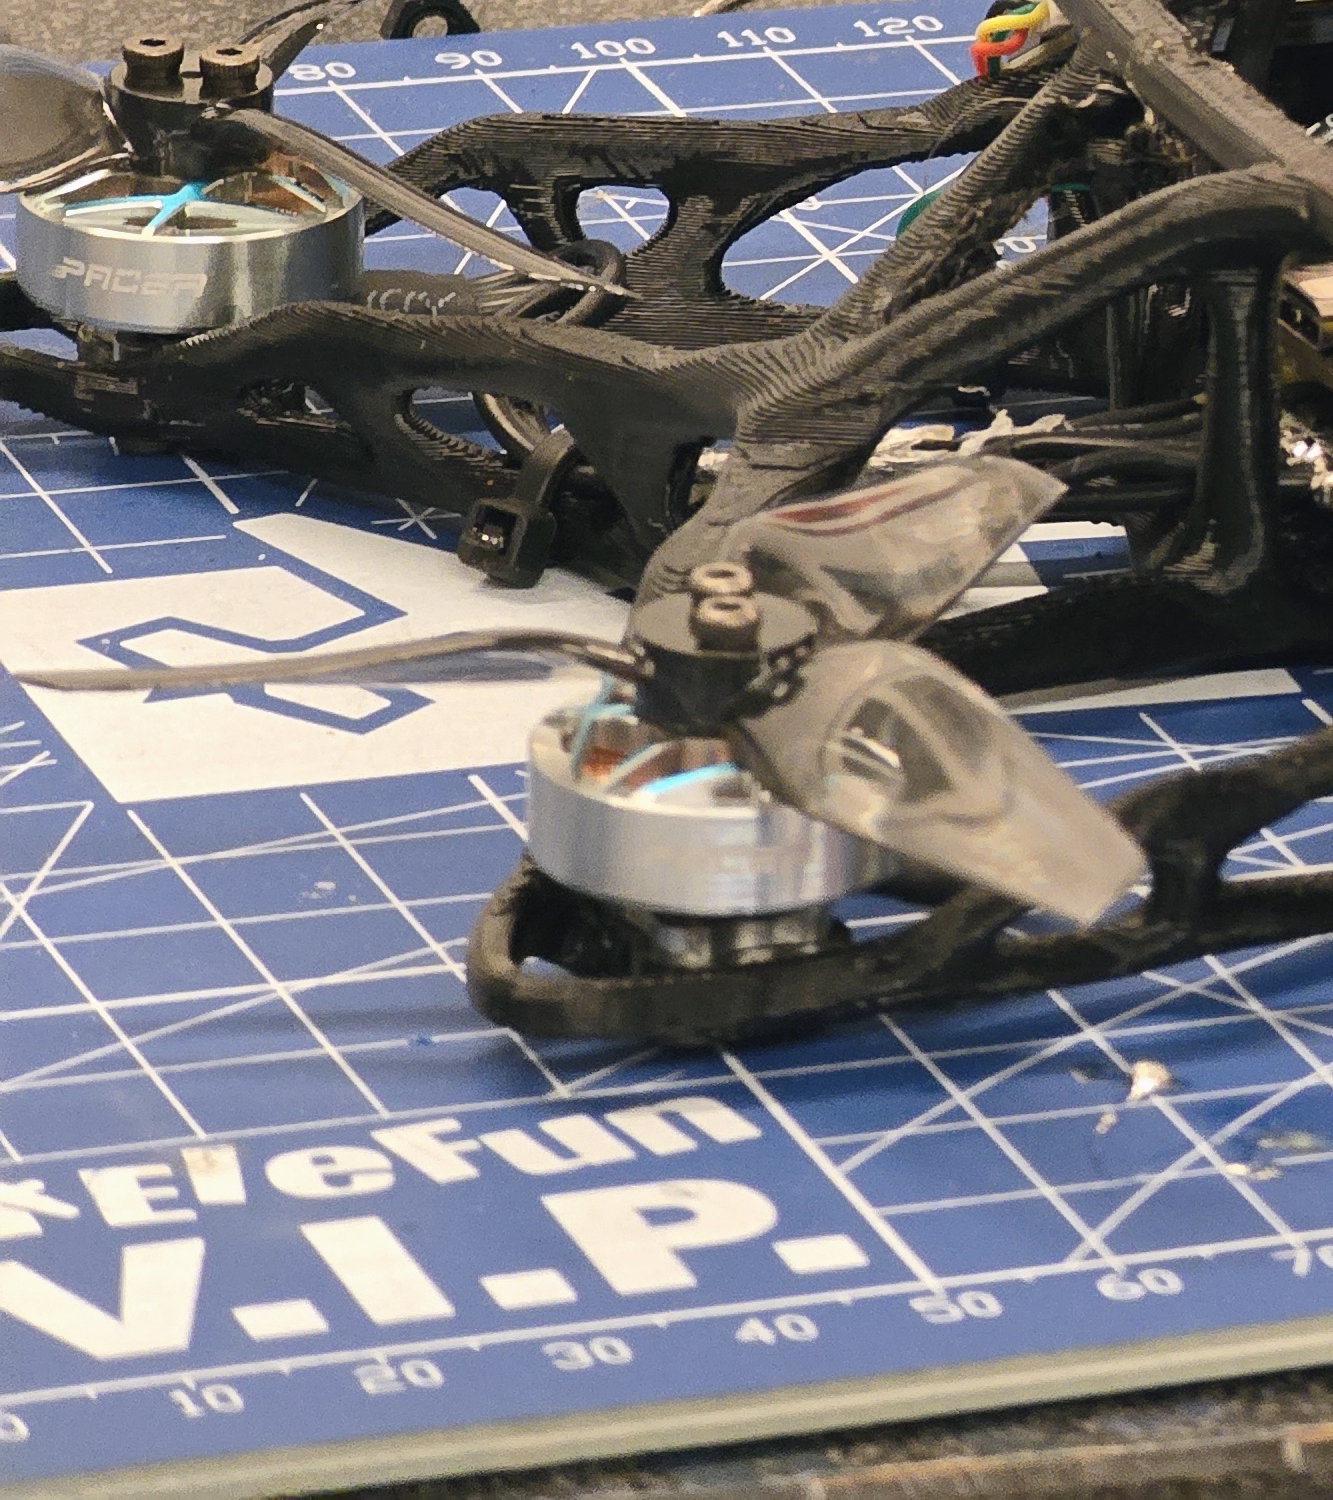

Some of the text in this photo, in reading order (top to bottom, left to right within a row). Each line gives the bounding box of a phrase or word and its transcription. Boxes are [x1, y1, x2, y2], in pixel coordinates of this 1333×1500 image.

[288, 61, 357, 82] 80
[434, 49, 503, 70] 90
[571, 37, 657, 60] 100
[717, 26, 797, 48] 110
[853, 14, 944, 38] 120
[49, 256, 208, 297] PACER
[0, 1178, 870, 1361] V.I.P.
[168, 1382, 245, 1419] 10
[354, 1358, 445, 1395] 20
[541, 1334, 634, 1372] 30
[734, 1313, 819, 1346] 40
[908, 1290, 1004, 1325] 50
[1095, 1267, 1185, 1301] 60
